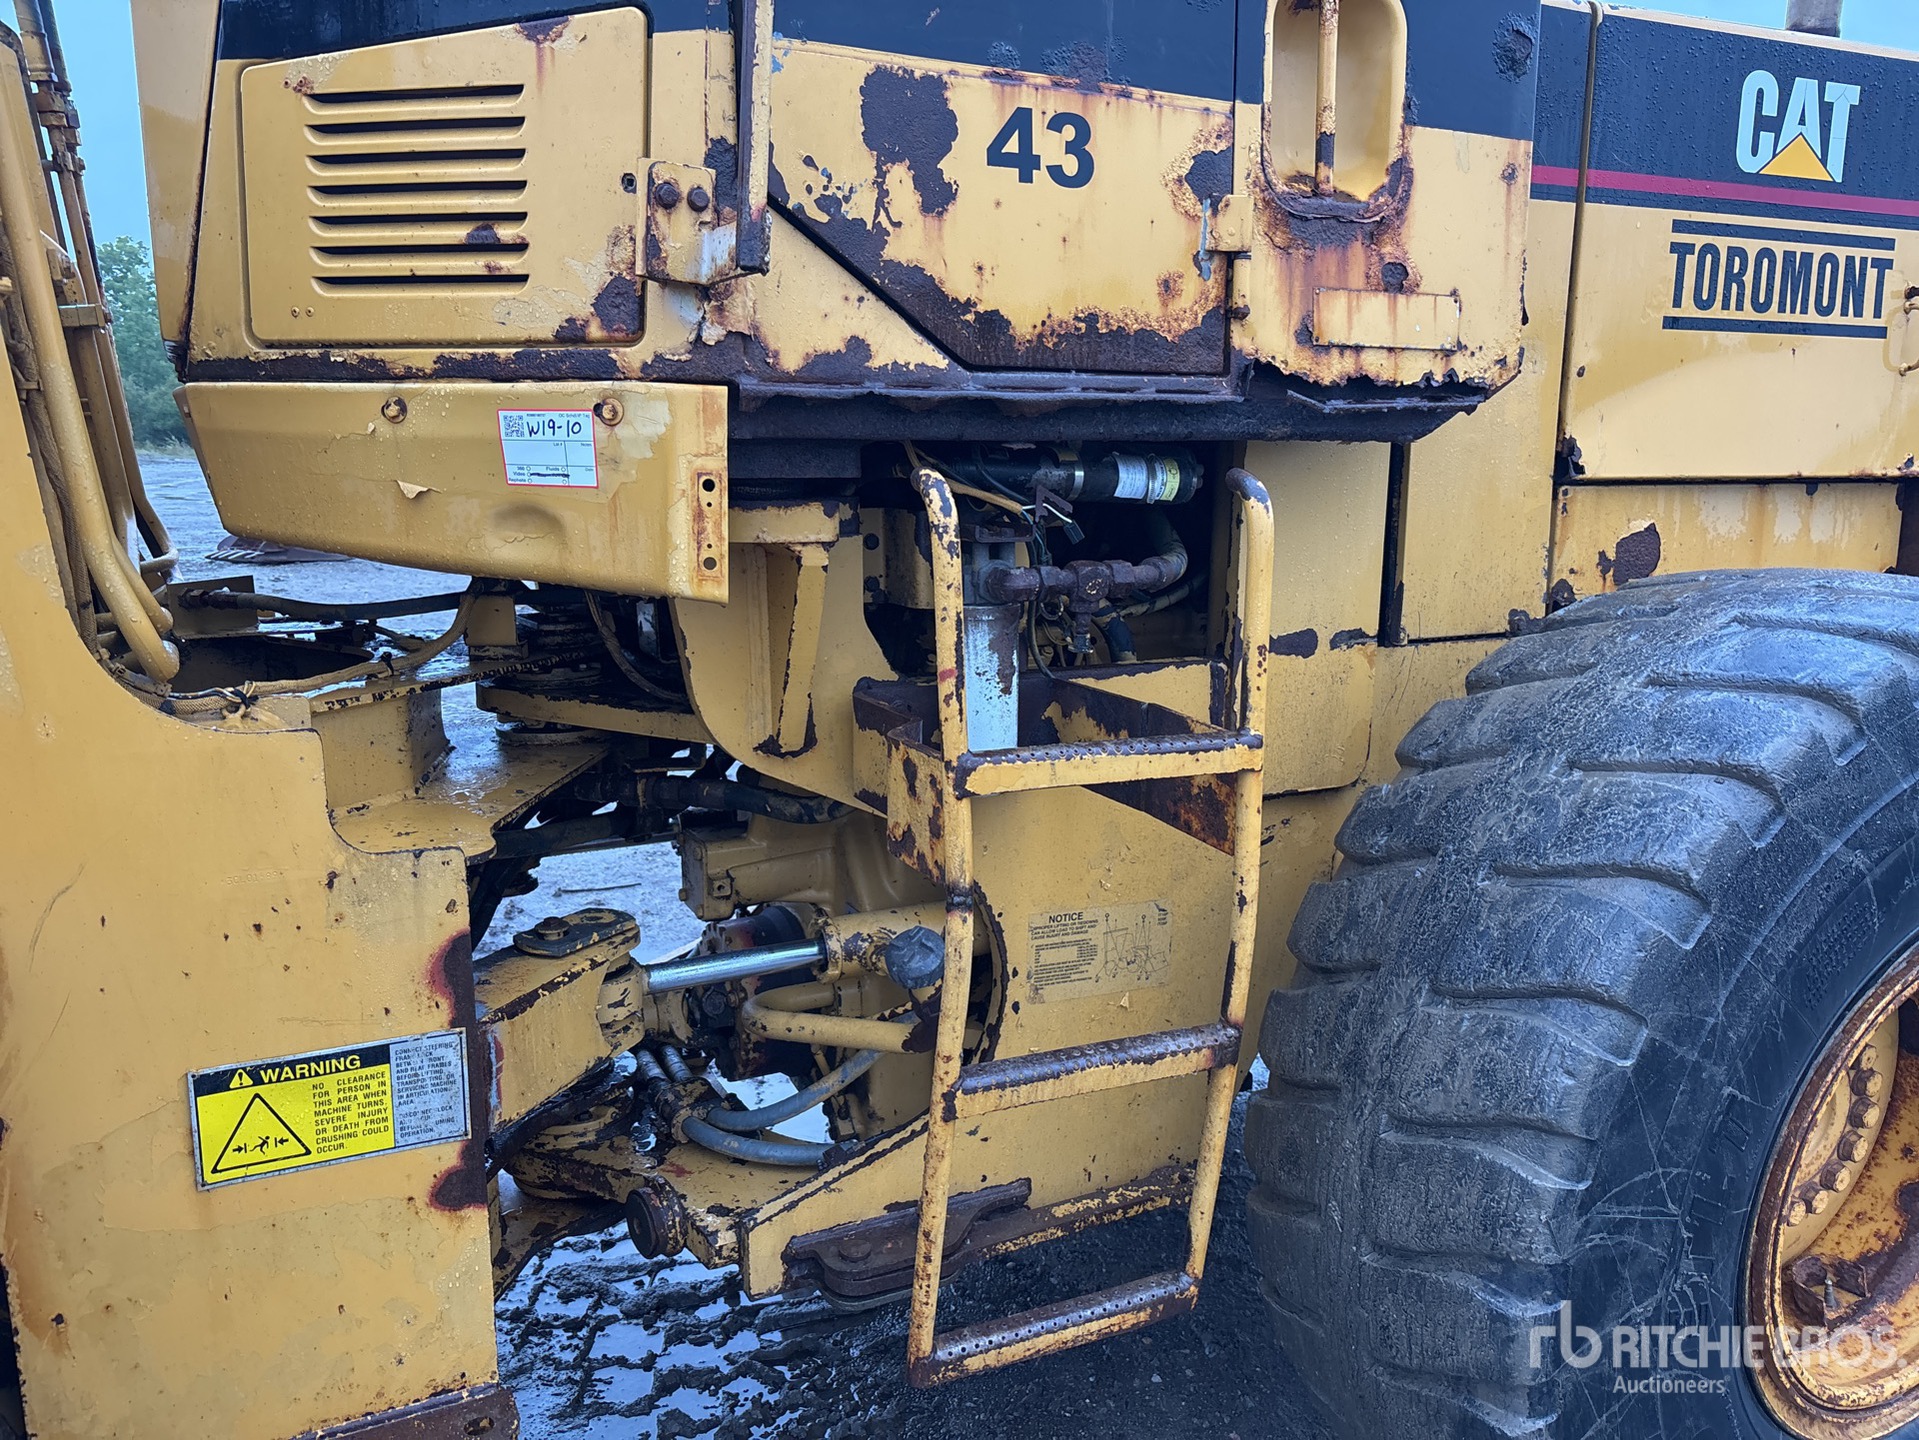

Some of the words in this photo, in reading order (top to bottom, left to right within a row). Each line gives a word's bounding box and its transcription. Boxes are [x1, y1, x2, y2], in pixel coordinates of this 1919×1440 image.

[1736, 70, 1861, 183] CAT
[987, 107, 1095, 188] 43
[1670, 242, 1894, 319] TOROMONT
[526, 418, 582, 438] W19-10
[1049, 912, 1084, 923] NOTICE
[259, 1054, 361, 1084] WARNING
[425, 1055, 445, 1064] RONT
[312, 1082, 325, 1091] NO
[336, 1071, 386, 1087] CLEARANCE
[396, 1067, 409, 1075] AND
[313, 1090, 330, 1100] FOR
[337, 1083, 371, 1095] PERSON
[377, 1080, 386, 1088] IN
[430, 1079, 457, 1088] MACHINE
[313, 1099, 332, 1109] THIS
[337, 1094, 359, 1105] AREA
[363, 1089, 387, 1100] WHEN
[314, 1105, 352, 1118] MACHINE
[357, 1099, 388, 1110] TURNS.
[315, 1114, 347, 1127] SEVERE
[357, 1107, 388, 1119] INJURY
[315, 1127, 328, 1136] OR
[332, 1122, 360, 1133] DEATH
[365, 1116, 389, 1127] FROM
[316, 1131, 358, 1145] CRUSHING
[362, 1125, 389, 1136] COULD
[316, 1142, 348, 1154] OCCUR.
